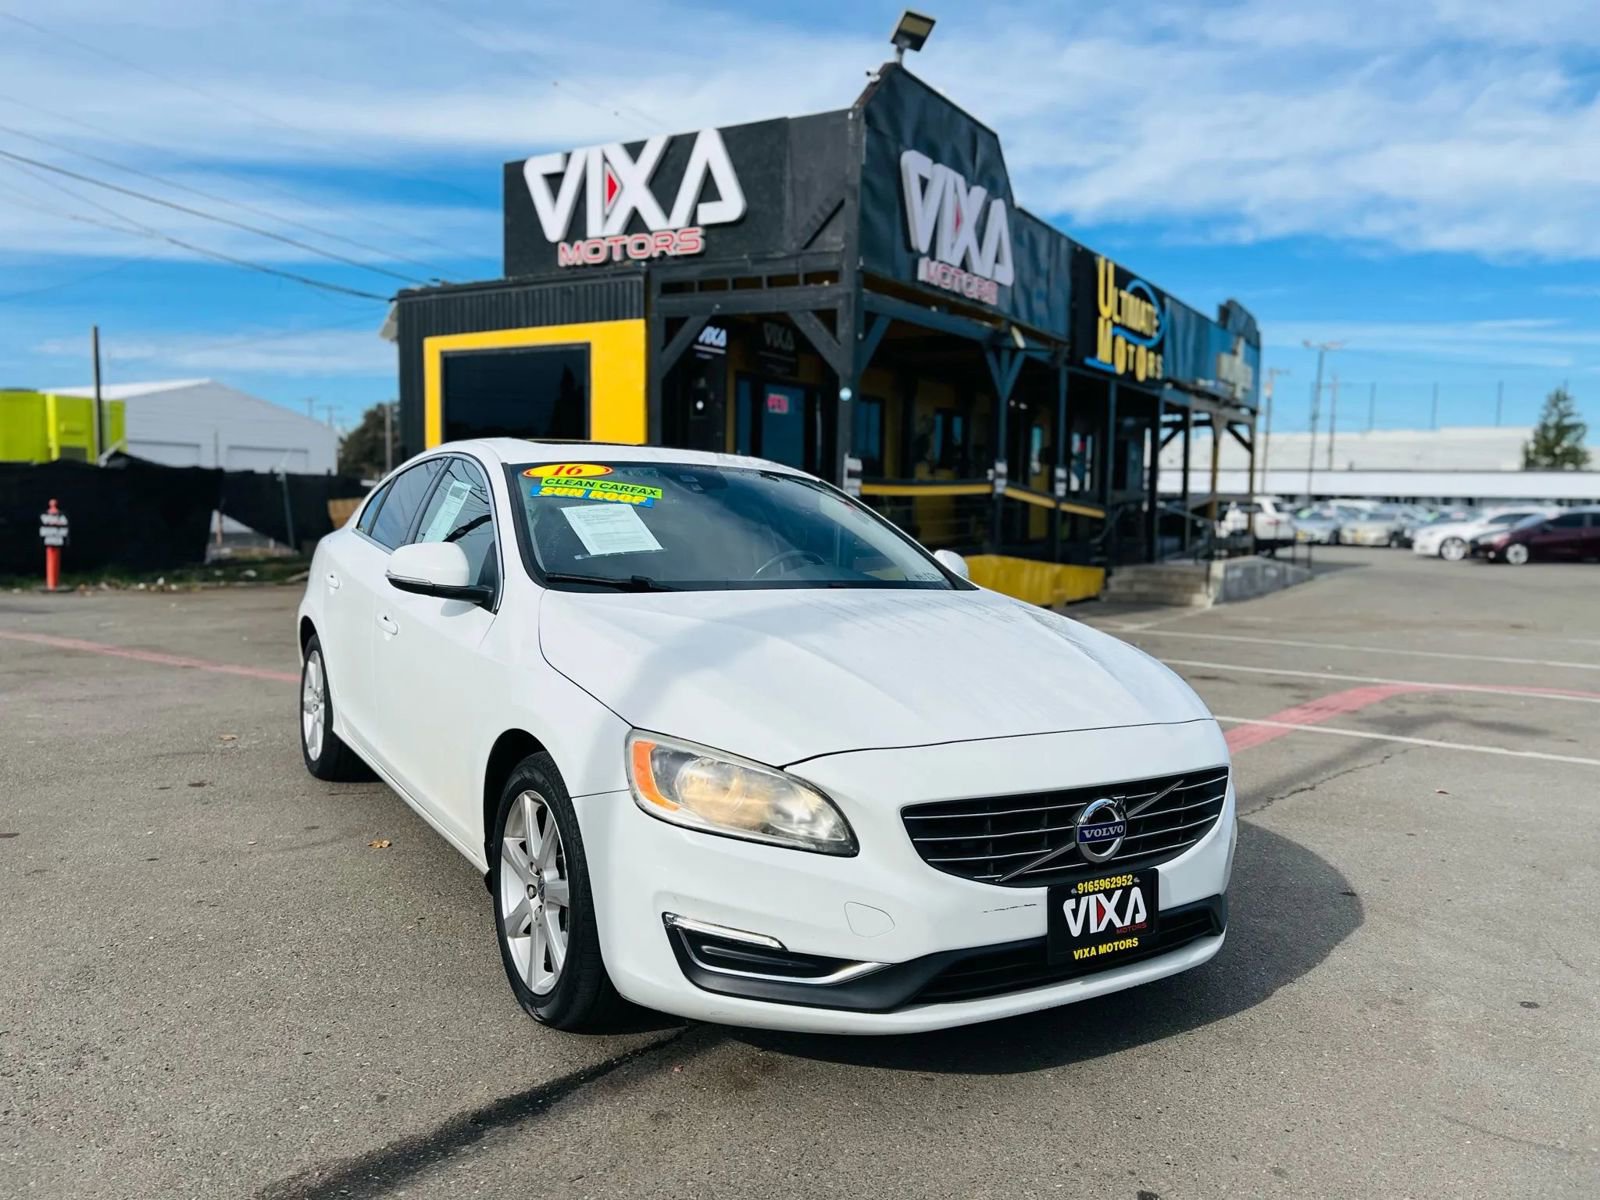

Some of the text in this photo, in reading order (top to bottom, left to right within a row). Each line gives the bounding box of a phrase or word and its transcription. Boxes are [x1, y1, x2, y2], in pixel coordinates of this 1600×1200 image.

[523, 127, 747, 243] VIXA
[901, 150, 1015, 287] VIXA
[557, 226, 705, 267] MOTORS
[917, 256, 999, 306] MOTORS
[553, 465, 583, 476] 16
[540, 486, 647, 504] SUN ROOF
[545, 477, 657, 496] CLEAN CARFAX
[1082, 824, 1124, 839] VOLVO
[1077, 874, 1133, 894] 9165962952
[1063, 886, 1147, 938] VIXA
[1116, 922, 1148, 934] MOTORS
[1073, 937, 1138, 960] VIXA MOTORS
